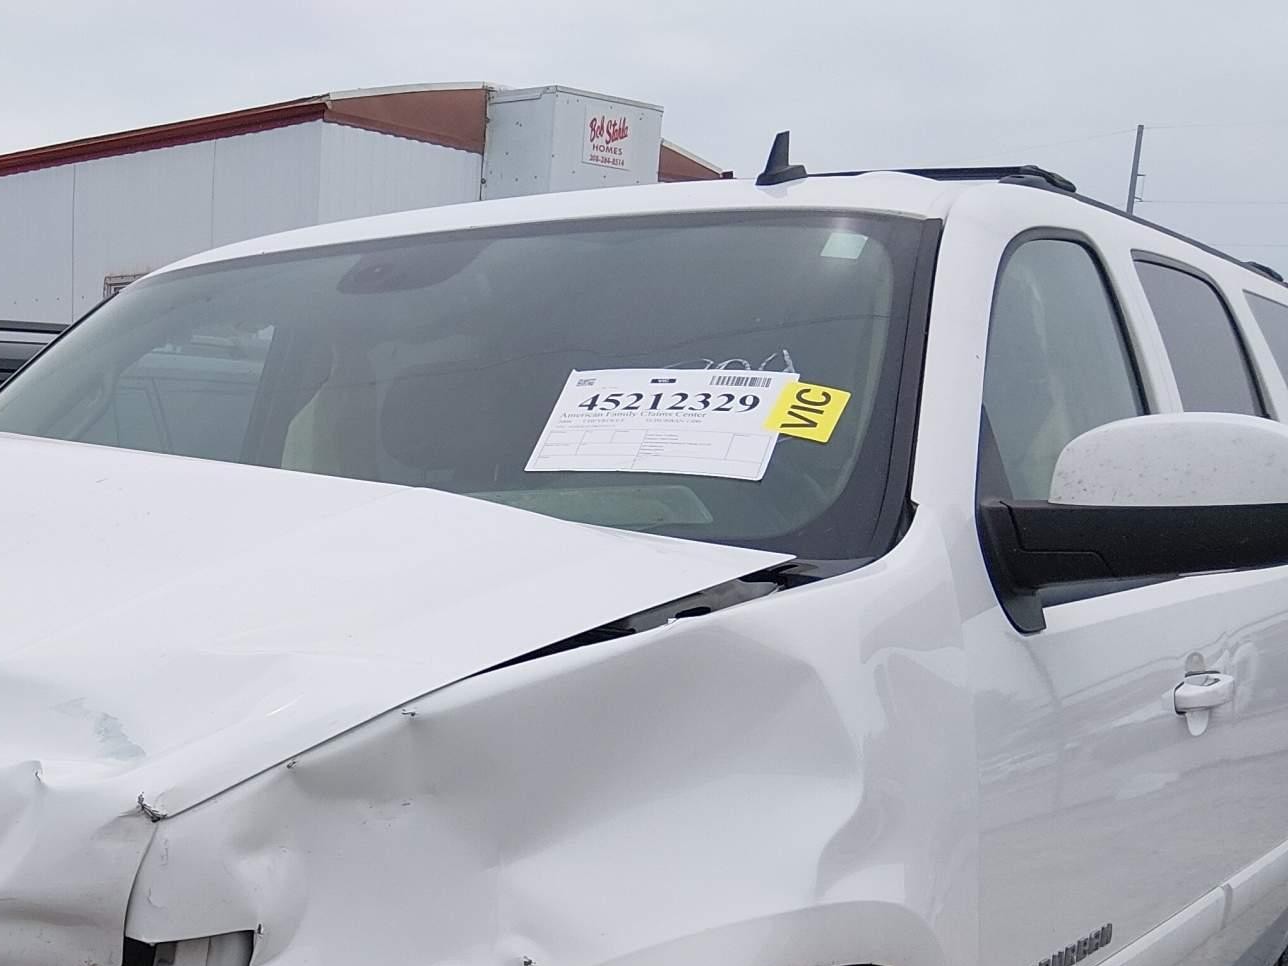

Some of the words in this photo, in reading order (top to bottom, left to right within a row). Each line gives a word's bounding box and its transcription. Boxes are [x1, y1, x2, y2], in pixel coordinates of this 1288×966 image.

[593, 144, 623, 155] HOMES
[577, 392, 761, 413] 45212329
[779, 388, 832, 428] VIC
